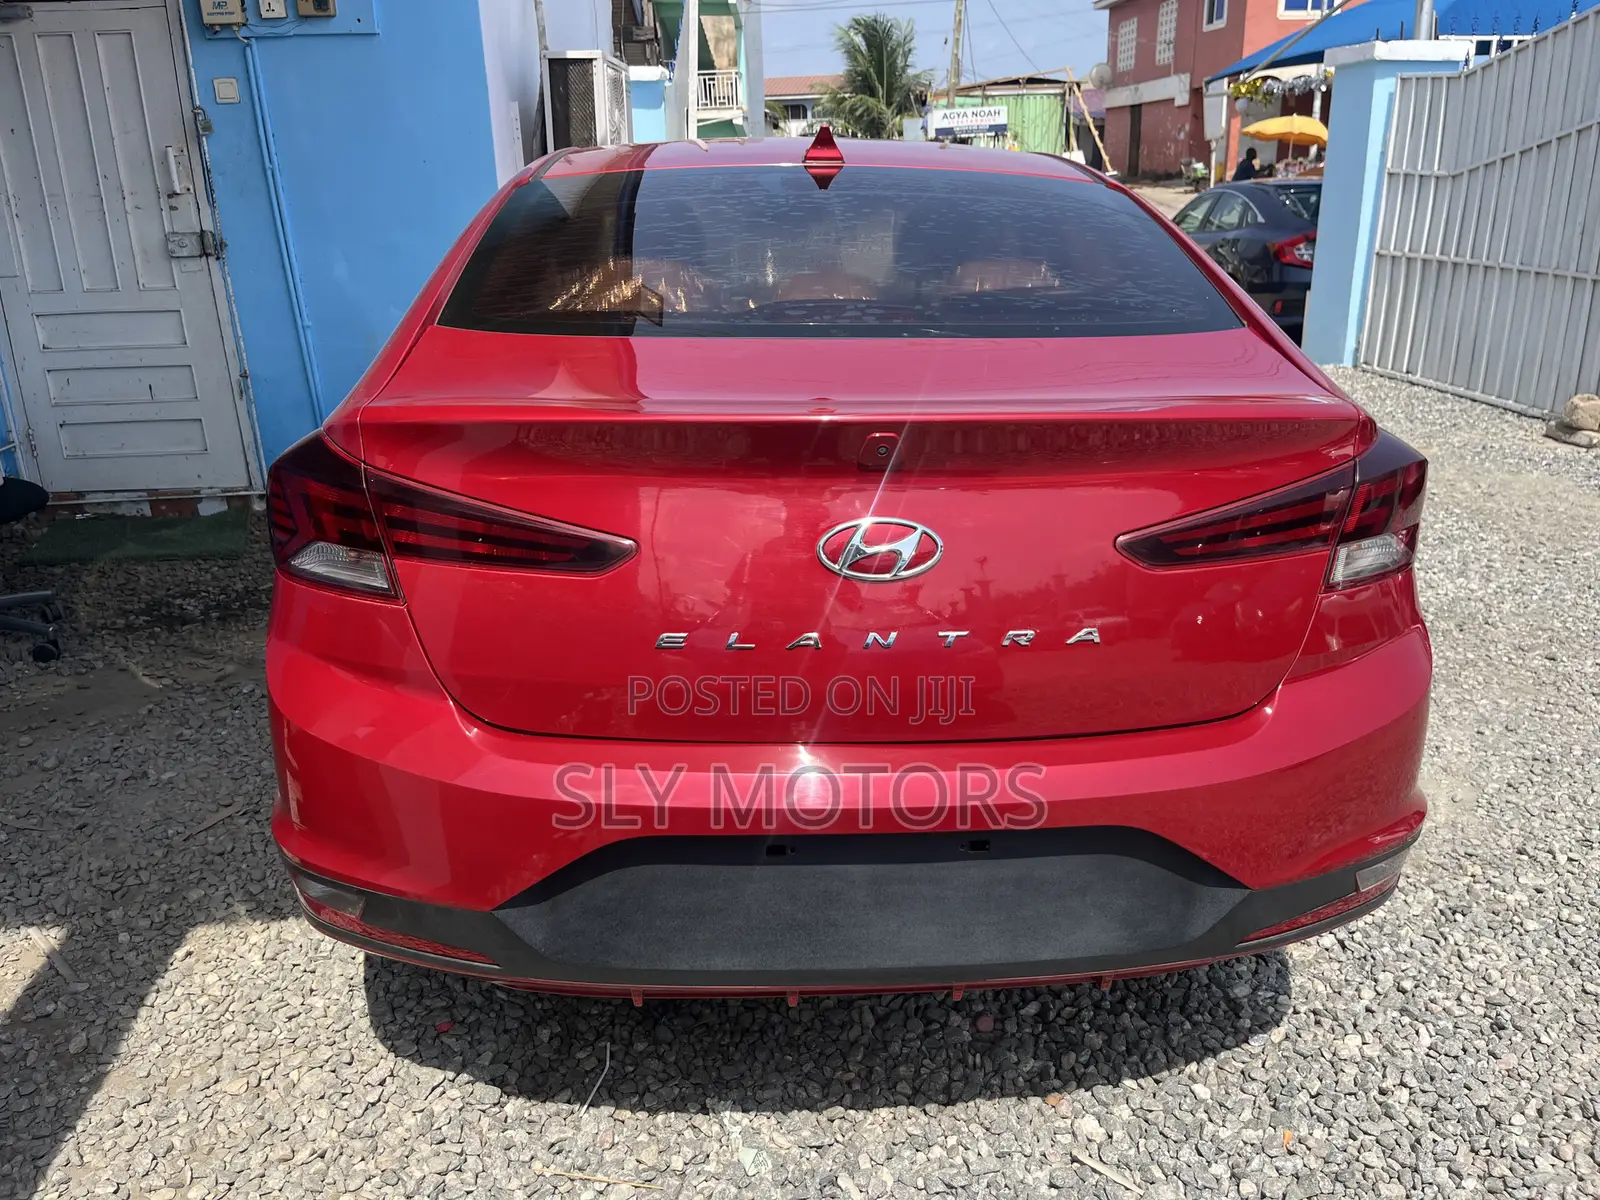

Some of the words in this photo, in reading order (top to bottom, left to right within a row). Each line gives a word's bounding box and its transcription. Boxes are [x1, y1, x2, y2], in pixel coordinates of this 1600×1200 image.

[942, 111, 968, 120] AGYA
[971, 109, 1000, 118] NOAH
[654, 627, 1102, 649] ELANTRA
